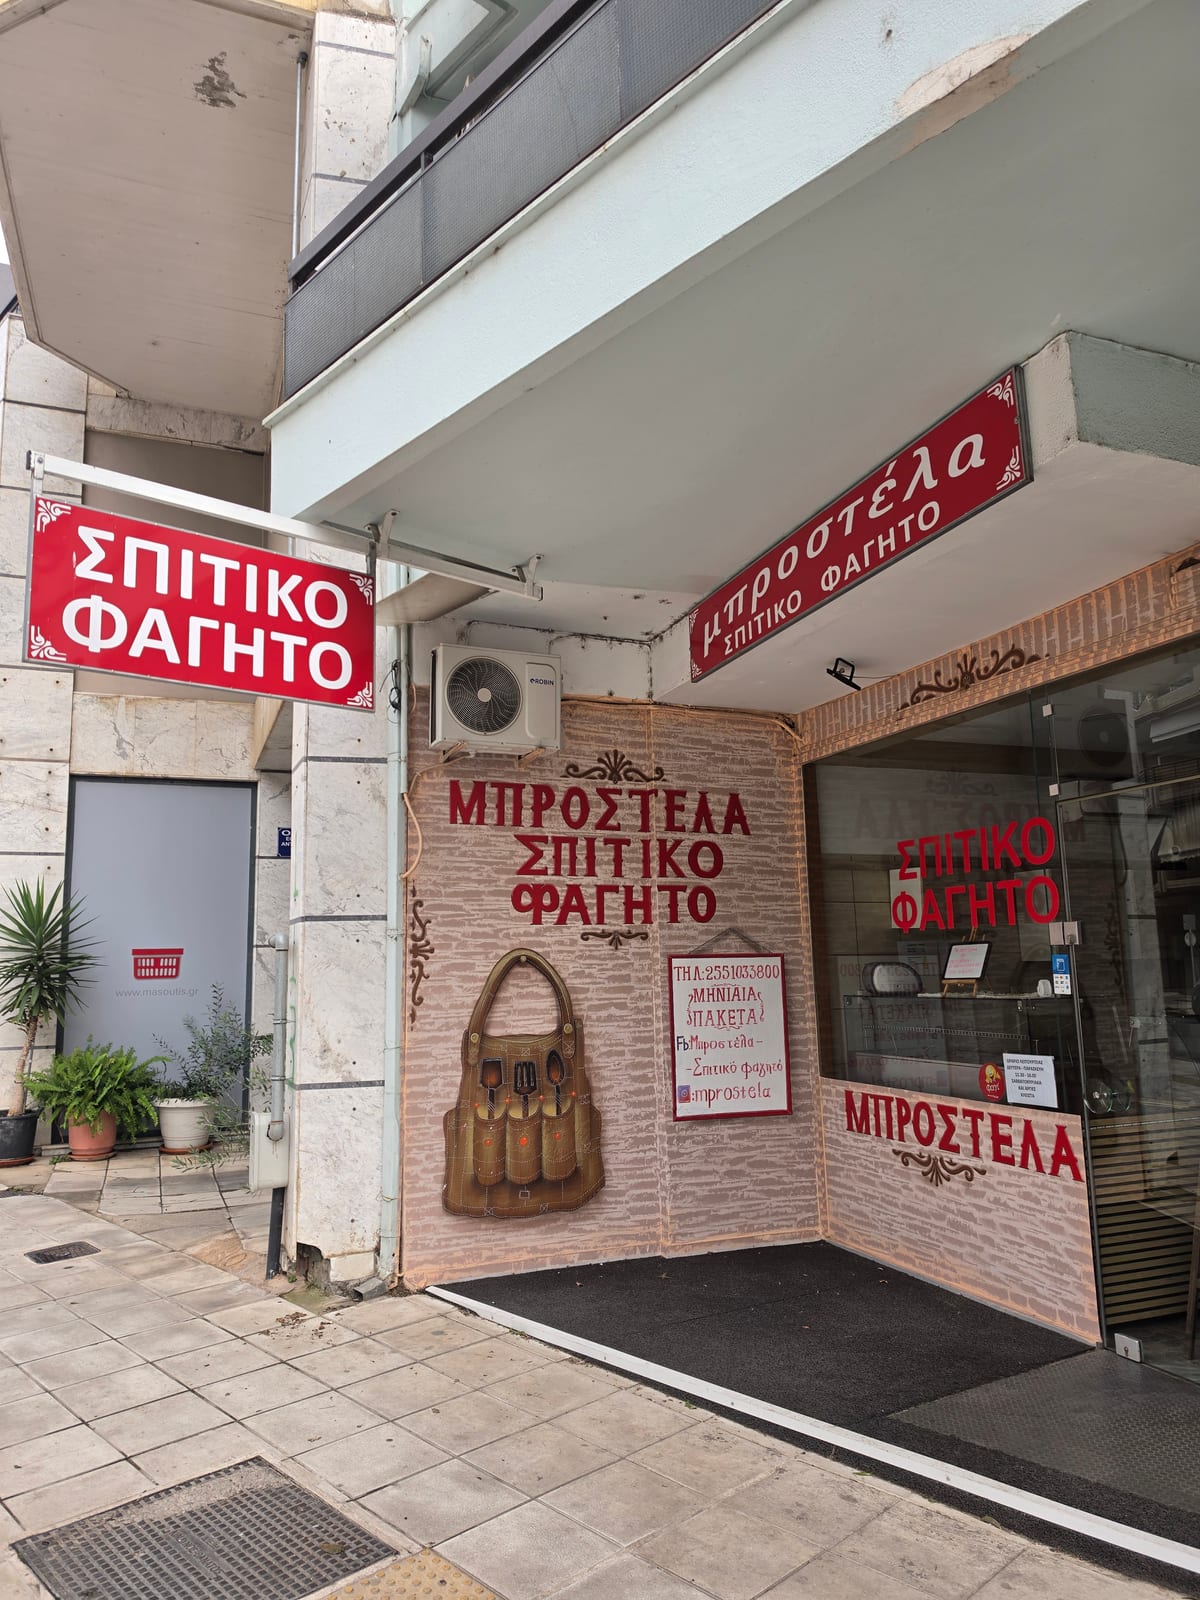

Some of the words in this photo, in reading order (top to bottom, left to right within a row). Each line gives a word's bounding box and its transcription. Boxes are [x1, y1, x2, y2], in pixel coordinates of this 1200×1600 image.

[703, 433, 986, 658] μπροστέλα
[75, 525, 348, 629] ΣΠΙΤΙΚΟ
[724, 590, 802, 656] ΣΠΙΤΙΚΟ
[820, 501, 940, 592] ΦΑΓΗΤΟ
[62, 594, 353, 690] ΦΑΓΗΤΟ
[450, 780, 750, 835] ΜΠΡΟΣΤΕΛΑ
[513, 834, 724, 879] ΣΠΙΤΙΚΟ
[897, 816, 1056, 881] ΣΠΙΤΙΚΟ
[511, 883, 717, 926] ΦΑΓΗΤΟ
[892, 876, 1060, 934] ΦΑΓΗΤΟ
[115, 986, 200, 998] www.masoutis.gr
[692, 1008, 758, 1028] ΠΑΚΕΤΑ
[693, 986, 758, 1003] ΜΗΝΙΑΙΑ
[844, 1089, 1086, 1183] ΜΠΡΟΣΤΕΛΑ
